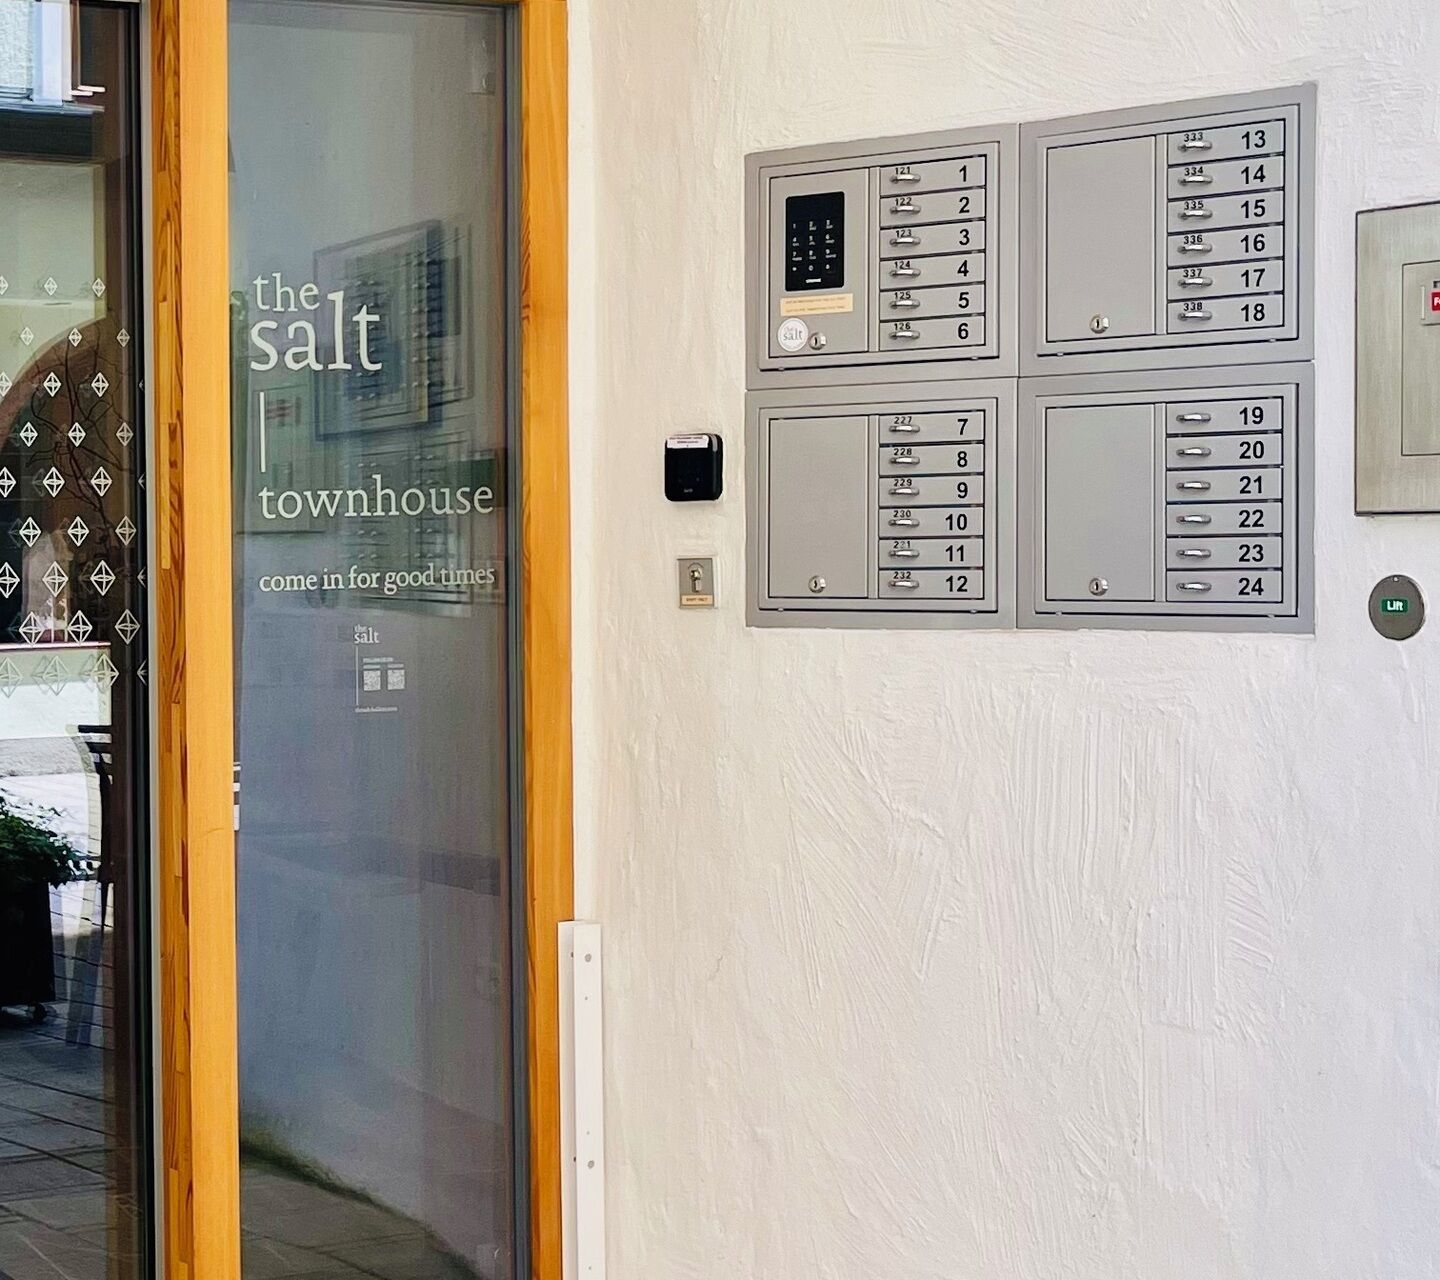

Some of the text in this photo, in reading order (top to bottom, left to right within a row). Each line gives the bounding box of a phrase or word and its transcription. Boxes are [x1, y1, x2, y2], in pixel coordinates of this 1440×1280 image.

[1183, 131, 1204, 143] 333
[1241, 129, 1266, 150] 13
[895, 166, 911, 175] 121
[959, 165, 967, 182] 1
[1184, 166, 1204, 176] 334
[1240, 164, 1266, 184] 14
[895, 196, 912, 206] 122
[958, 196, 970, 214] 2
[1183, 200, 1204, 210] 335
[1240, 199, 1266, 219] 15
[895, 229, 912, 238] 123
[958, 228, 970, 246] 3
[1183, 234, 1203, 245] 336
[1240, 233, 1266, 253] 16
[894, 260, 911, 269] 124
[957, 259, 970, 277] 4
[1183, 269, 1203, 278] 337
[1240, 268, 1266, 288] 17
[253, 272, 320, 312] the
[894, 291, 912, 300] 125
[958, 291, 970, 309] 5
[1183, 302, 1203, 312] 338
[1240, 302, 1266, 322] 18
[250, 290, 382, 371] salt
[783, 328, 803, 341] salt
[957, 322, 969, 340] 6
[893, 416, 913, 424] 227
[1239, 406, 1264, 426] 19
[957, 418, 969, 436] 7
[893, 447, 913, 456] 228
[957, 450, 968, 468] 8
[1239, 440, 1265, 460] 20
[893, 478, 913, 487] 229
[957, 481, 968, 499] 9
[1239, 475, 1263, 494] 21
[258, 474, 494, 519] townhouse
[893, 510, 912, 518] 230
[945, 513, 968, 531] 10
[1238, 509, 1265, 529] 22
[945, 544, 965, 562] 11
[1238, 544, 1264, 563] 23
[259, 563, 495, 595] come in for good times
[893, 571, 912, 580] 232
[945, 575, 968, 593] 12
[1238, 577, 1264, 596] 24
[1386, 600, 1404, 611] Lift
[354, 627, 380, 644] salt
